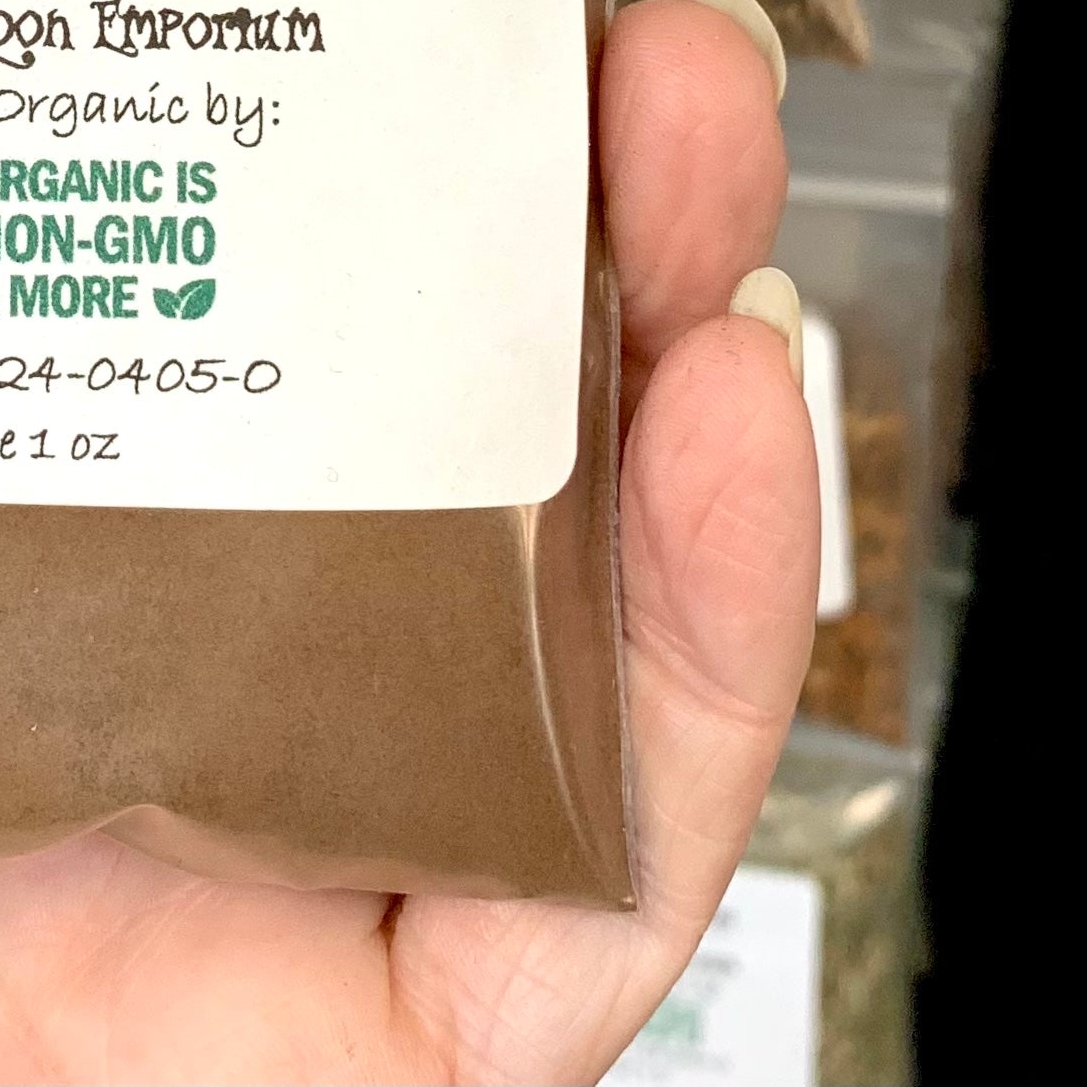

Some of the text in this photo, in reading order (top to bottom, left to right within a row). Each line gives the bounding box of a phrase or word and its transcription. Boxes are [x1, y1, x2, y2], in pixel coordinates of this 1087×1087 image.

[205, 81, 280, 148] by:
[177, 160, 218, 205] IS
[10, 275, 139, 319] MORE
[29, 428, 56, 460] 1
[70, 433, 121, 461] oz
